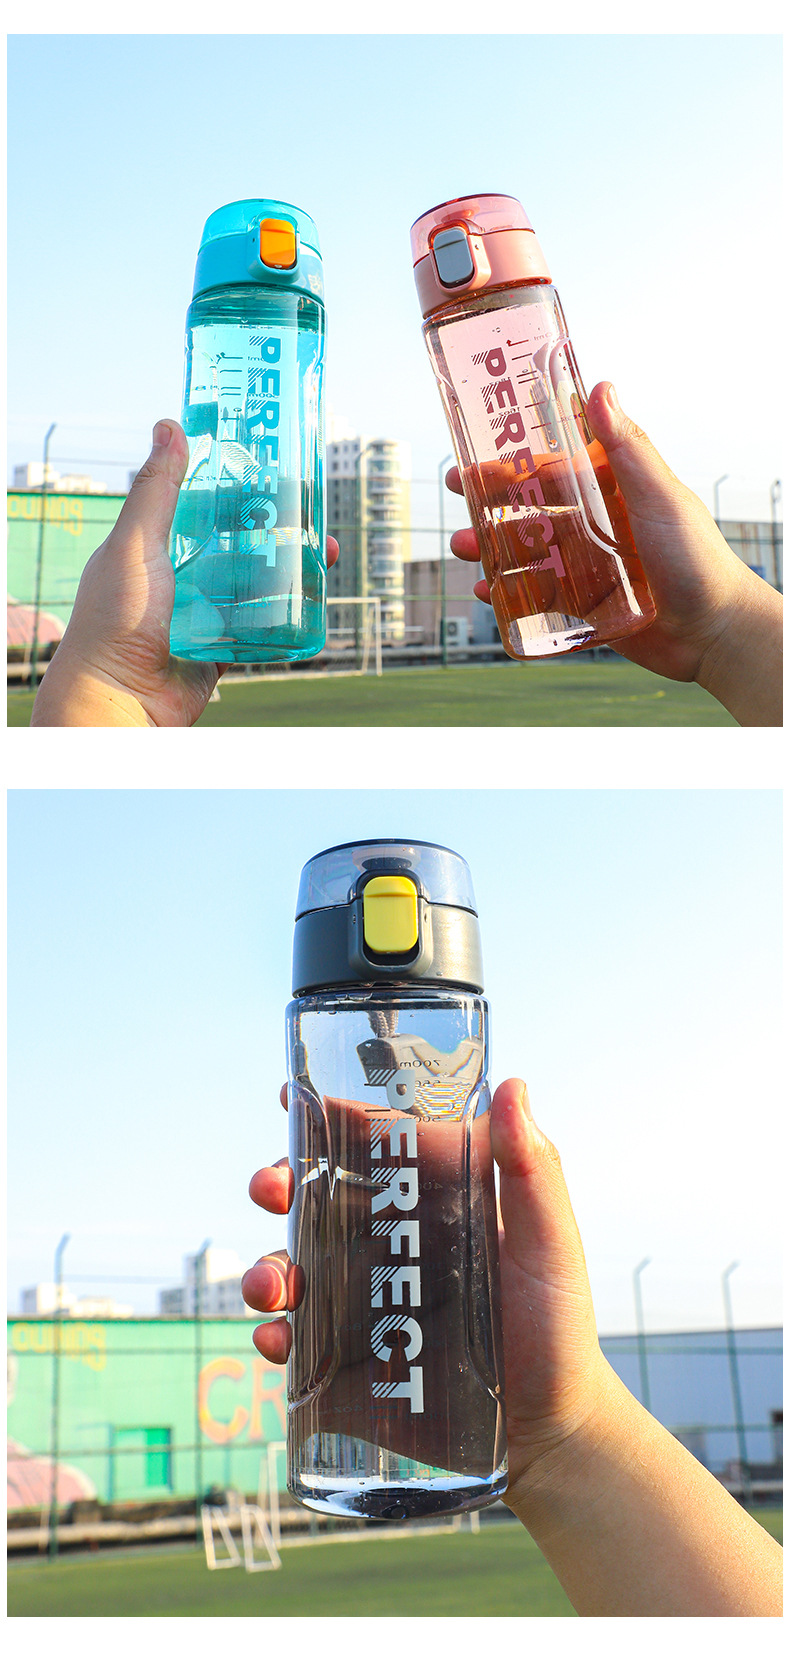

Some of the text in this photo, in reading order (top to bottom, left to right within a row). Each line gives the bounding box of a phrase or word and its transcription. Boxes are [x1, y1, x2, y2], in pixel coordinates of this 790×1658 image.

[240, 336, 281, 567] PERFECT
[471, 347, 566, 578] PERFECT
[369, 1069, 425, 1414] PERFECT
